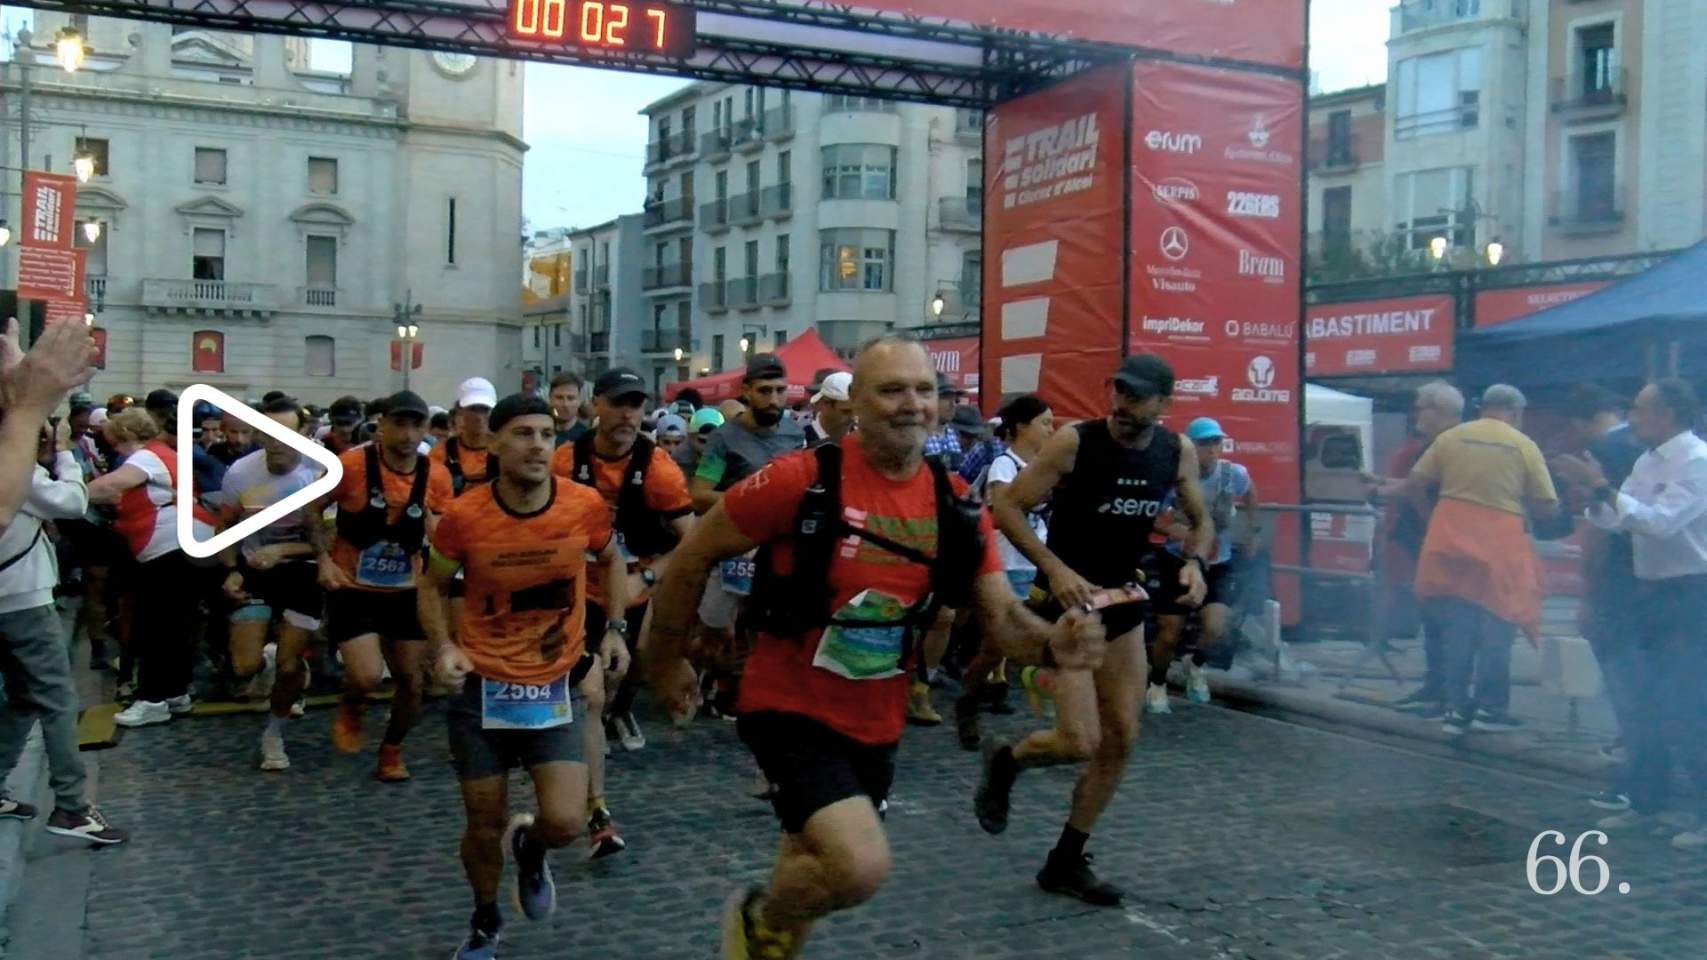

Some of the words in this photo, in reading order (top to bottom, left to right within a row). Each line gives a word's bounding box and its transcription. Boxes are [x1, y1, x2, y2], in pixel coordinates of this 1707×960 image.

[1027, 112, 1099, 161] TRAIL
[1145, 130, 1201, 154] erum
[1020, 144, 1097, 187] solidari
[1239, 249, 1284, 276] Bram
[1142, 315, 1204, 333] impriDekor
